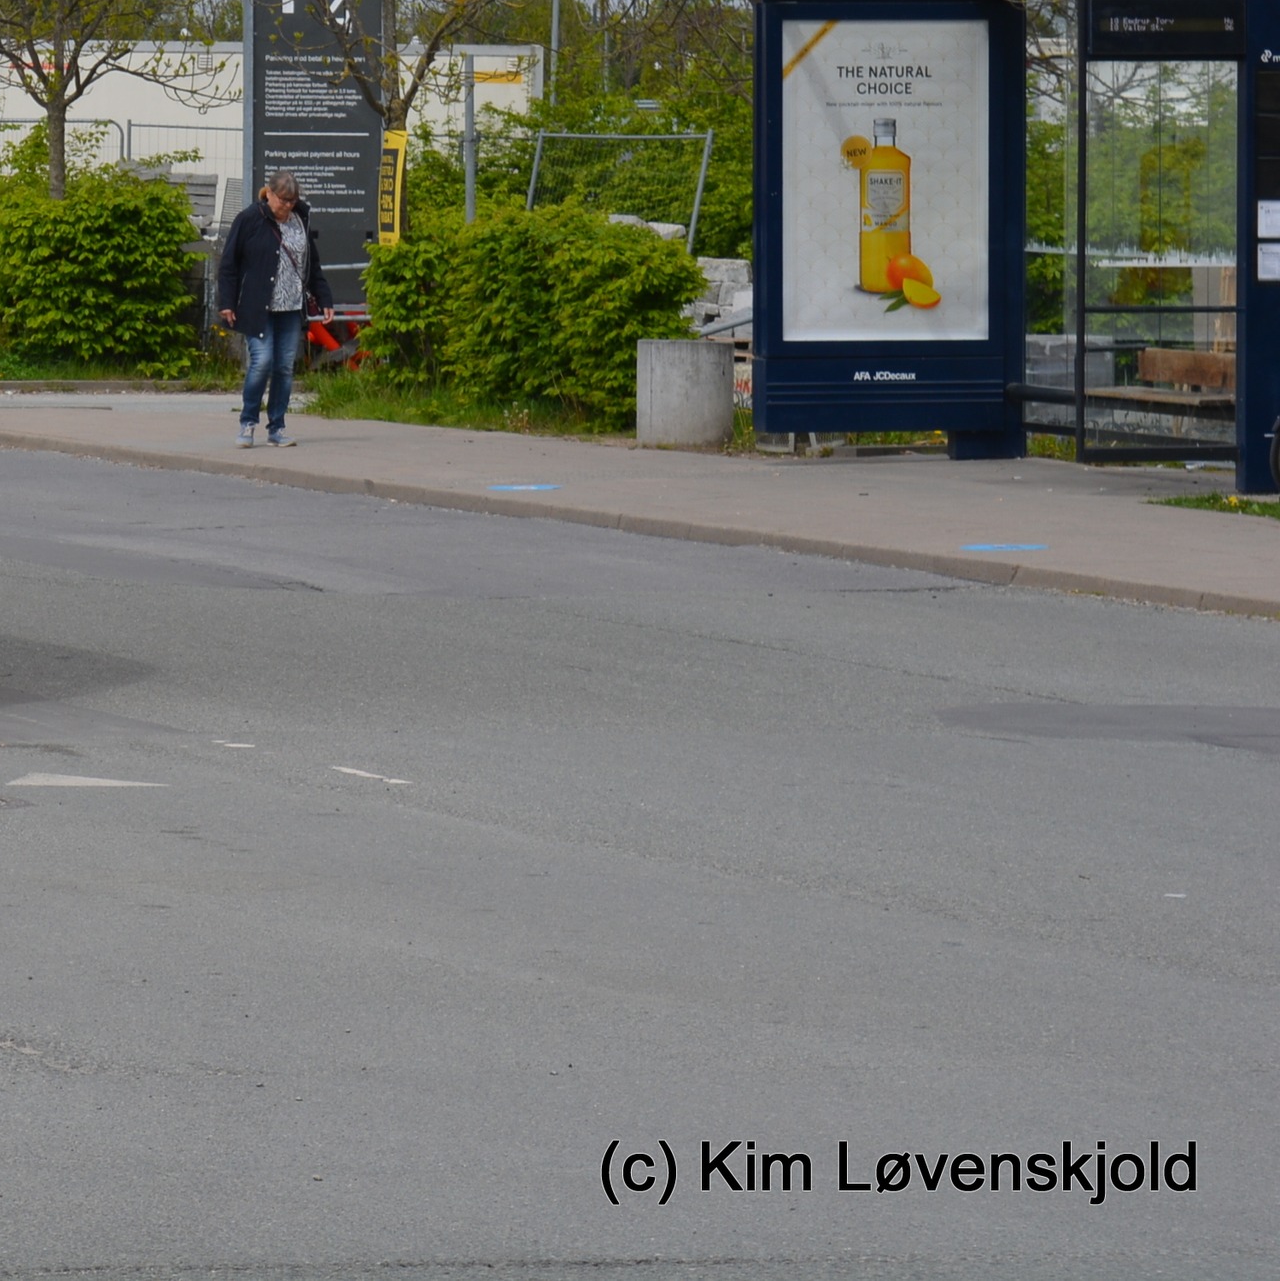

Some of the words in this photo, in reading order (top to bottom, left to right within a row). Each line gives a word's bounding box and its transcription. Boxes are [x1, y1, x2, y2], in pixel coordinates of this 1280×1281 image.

[837, 66, 864, 78] THE
[868, 66, 932, 78] NATURAL
[856, 82, 912, 94] CHOICE
[309, 151, 335, 159] payment
[846, 148, 866, 158] NEW
[853, 371, 871, 381] AFA
[873, 371, 916, 381] JCDecaux
